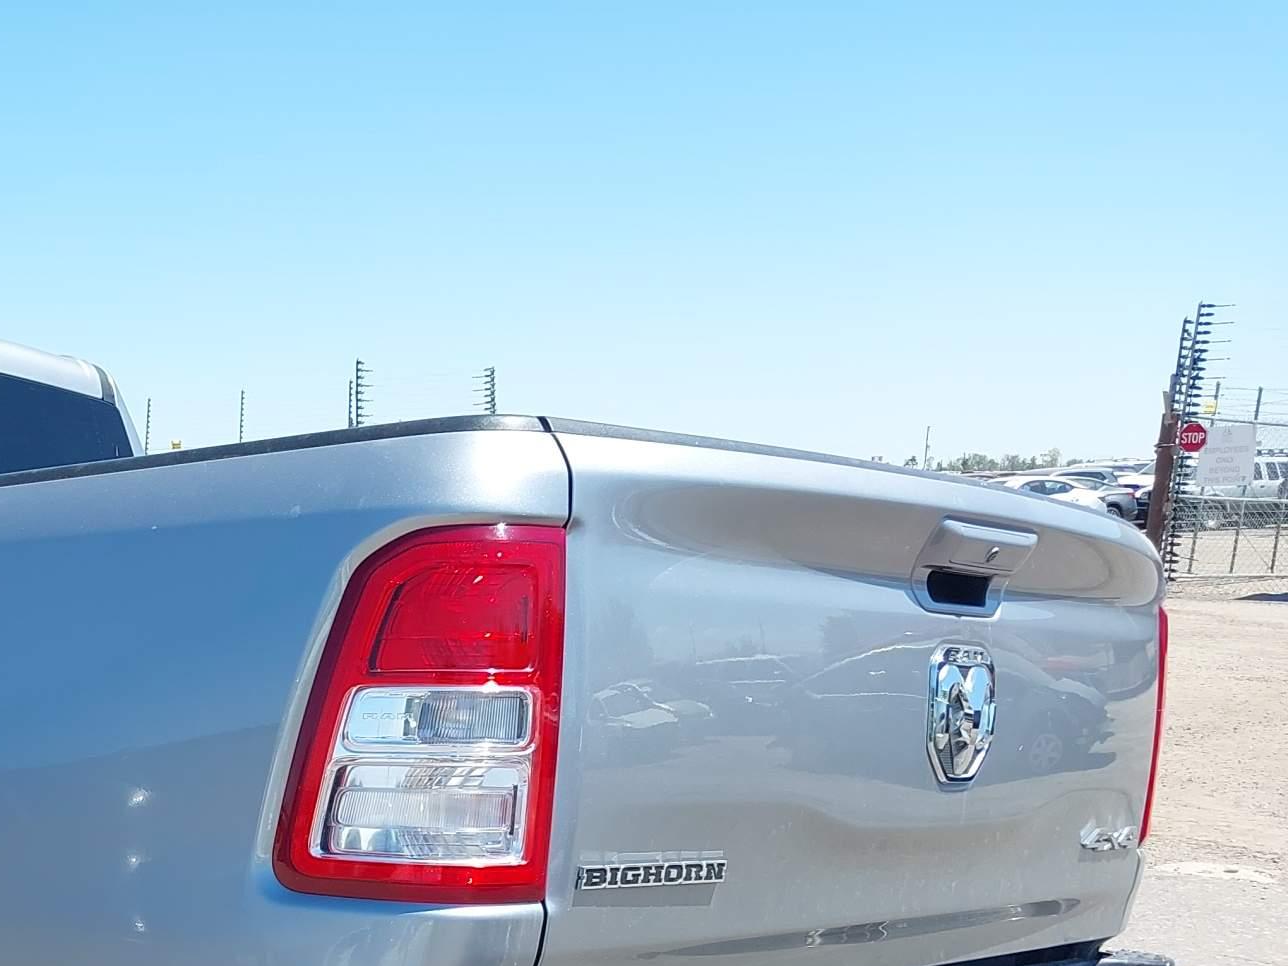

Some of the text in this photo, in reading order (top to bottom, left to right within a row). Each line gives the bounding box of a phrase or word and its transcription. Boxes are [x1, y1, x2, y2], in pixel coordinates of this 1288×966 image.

[1181, 432, 1205, 444] STOP
[362, 712, 413, 720] RAM
[580, 860, 728, 890] BIGHORN
